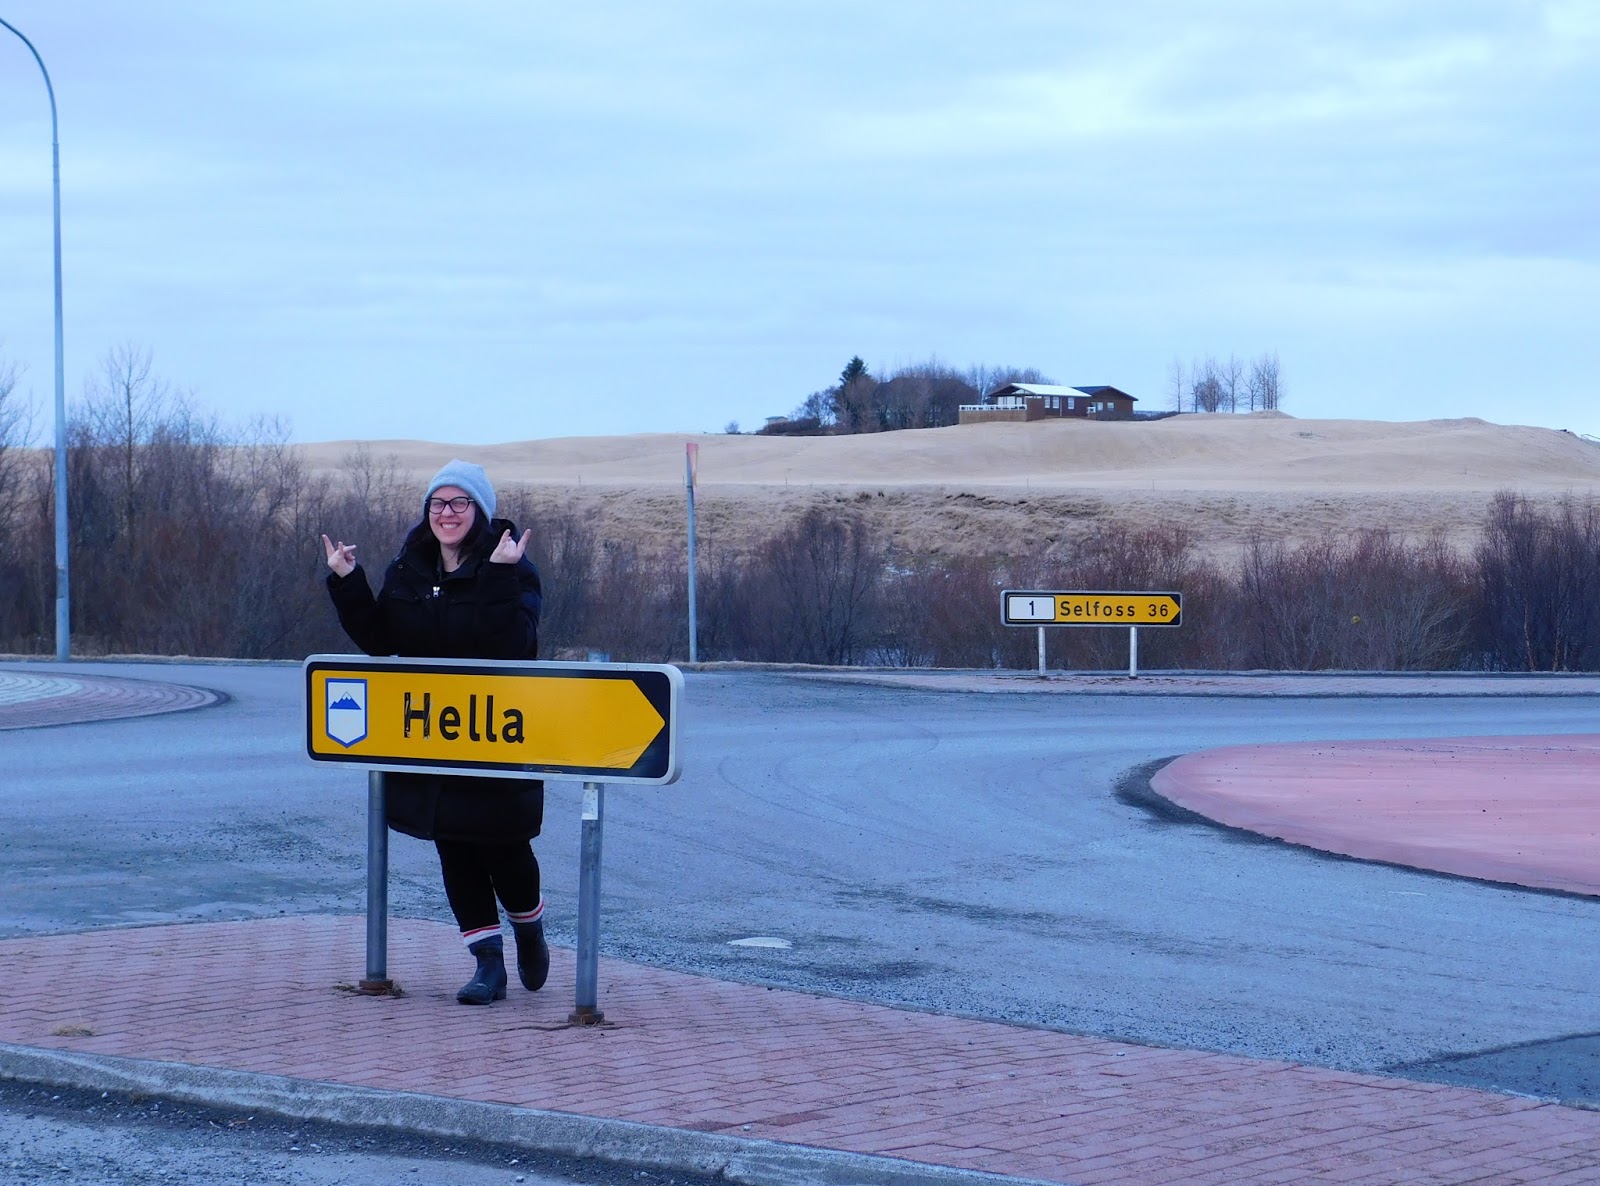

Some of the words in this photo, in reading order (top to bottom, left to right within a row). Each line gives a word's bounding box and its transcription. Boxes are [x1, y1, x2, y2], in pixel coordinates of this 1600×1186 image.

[1028, 600, 1035, 616] 1
[1060, 600, 1136, 617] Selfoss
[1148, 603, 1169, 617] 36
[403, 691, 526, 744] Hella
